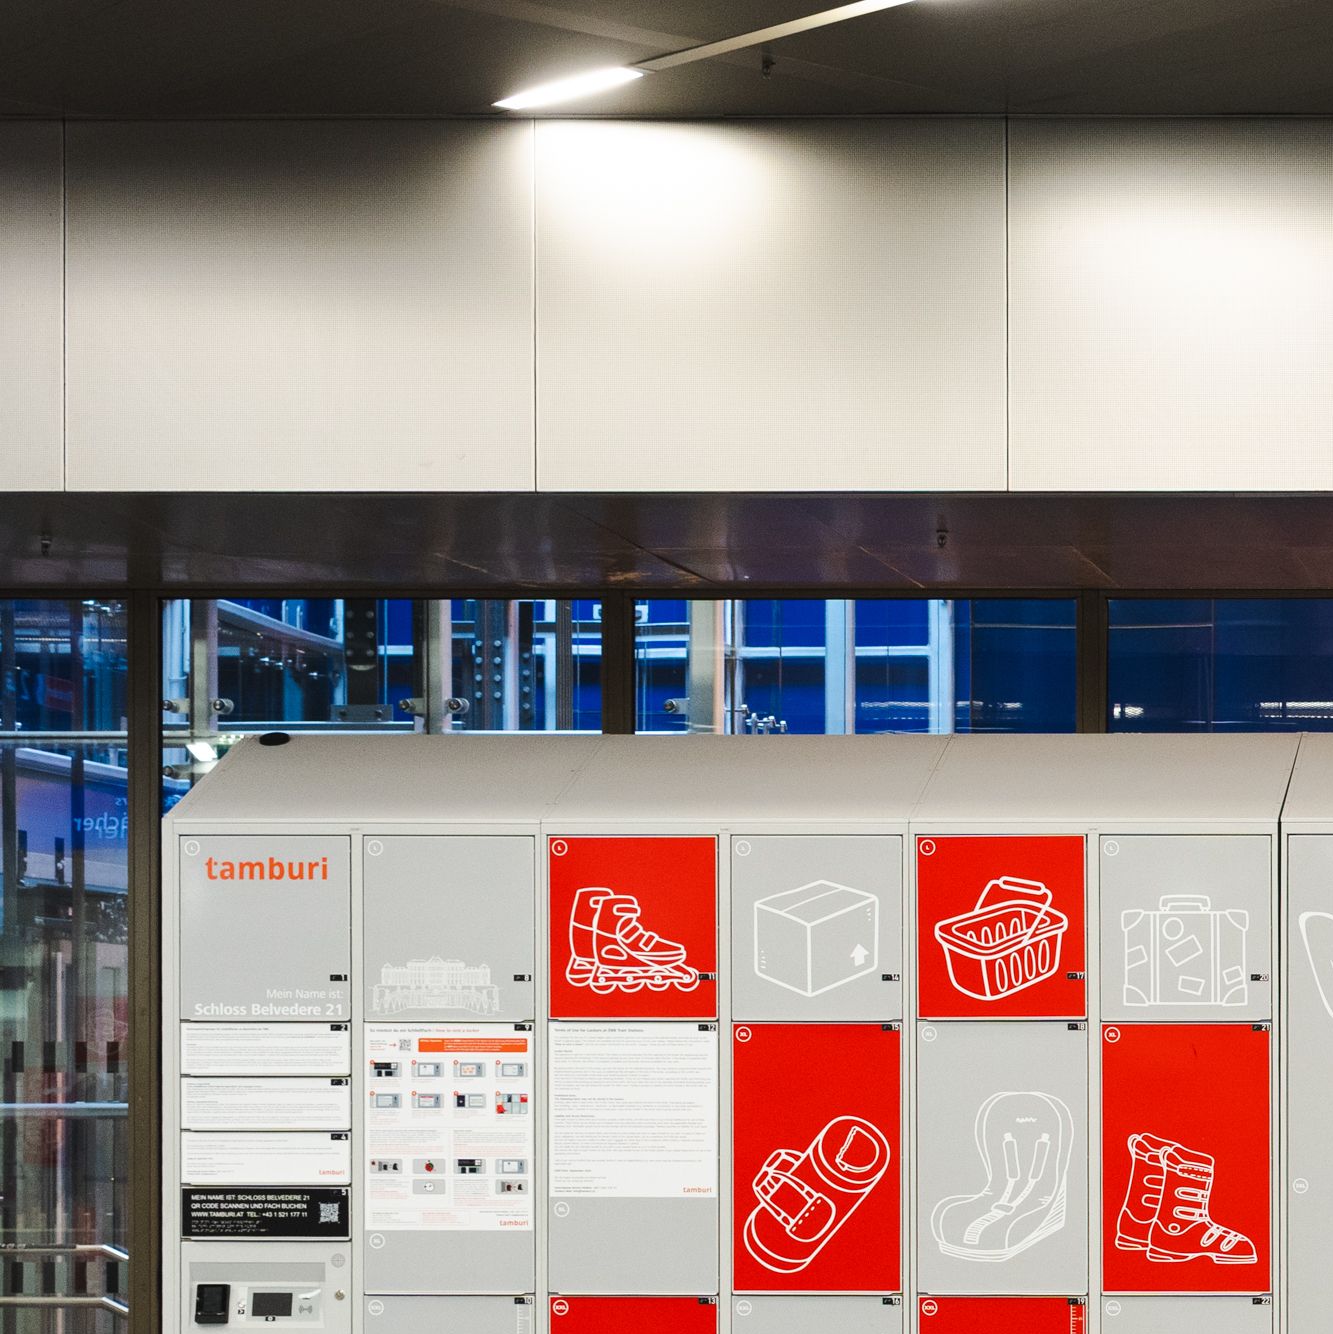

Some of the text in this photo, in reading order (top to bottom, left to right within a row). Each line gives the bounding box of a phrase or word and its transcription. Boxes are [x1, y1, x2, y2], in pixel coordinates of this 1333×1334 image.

[205, 857, 328, 880] tamburi
[266, 989, 343, 998] Mein Name ist:
[195, 1003, 342, 1015] Schloss Belvedere 21
